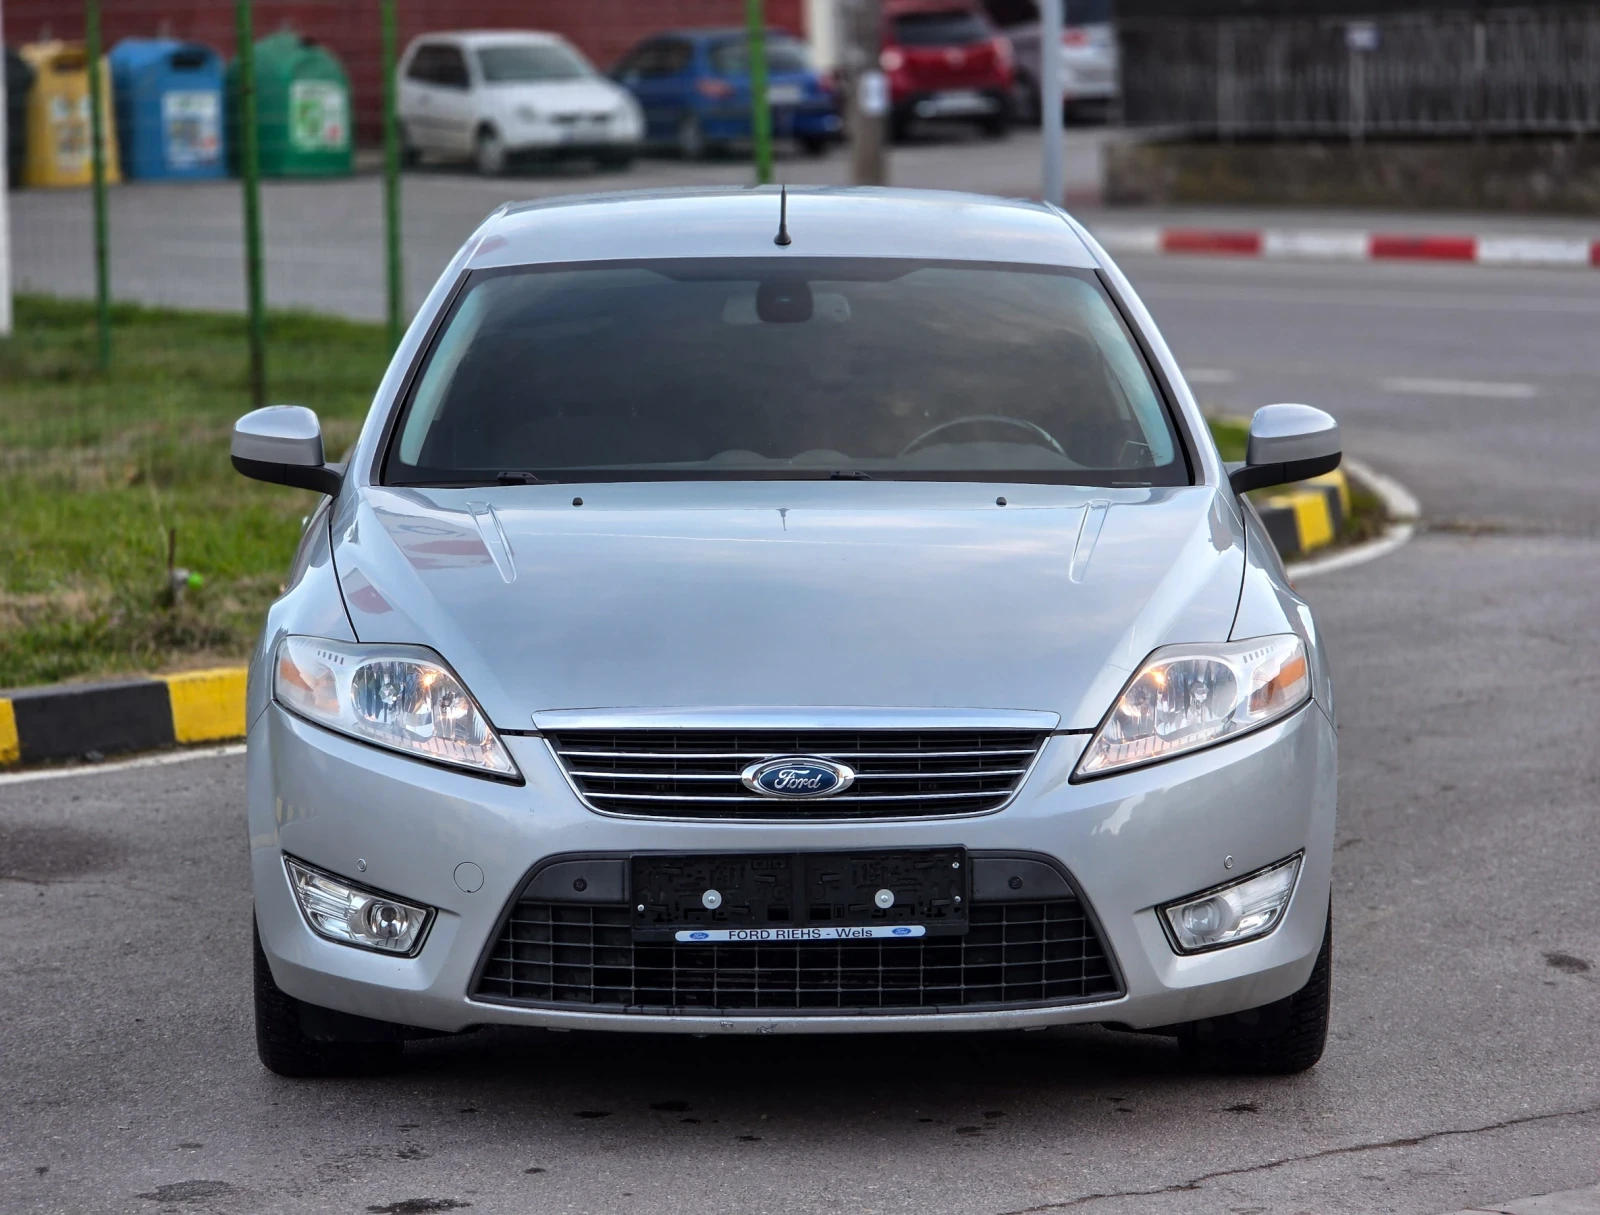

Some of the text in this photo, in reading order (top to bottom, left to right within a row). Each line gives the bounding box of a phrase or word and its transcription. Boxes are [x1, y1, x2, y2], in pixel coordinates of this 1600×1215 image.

[774, 769, 822, 788] Ford
[728, 930, 771, 940] FORD
[776, 929, 822, 940] RIEHS
[835, 928, 873, 938] Wels
